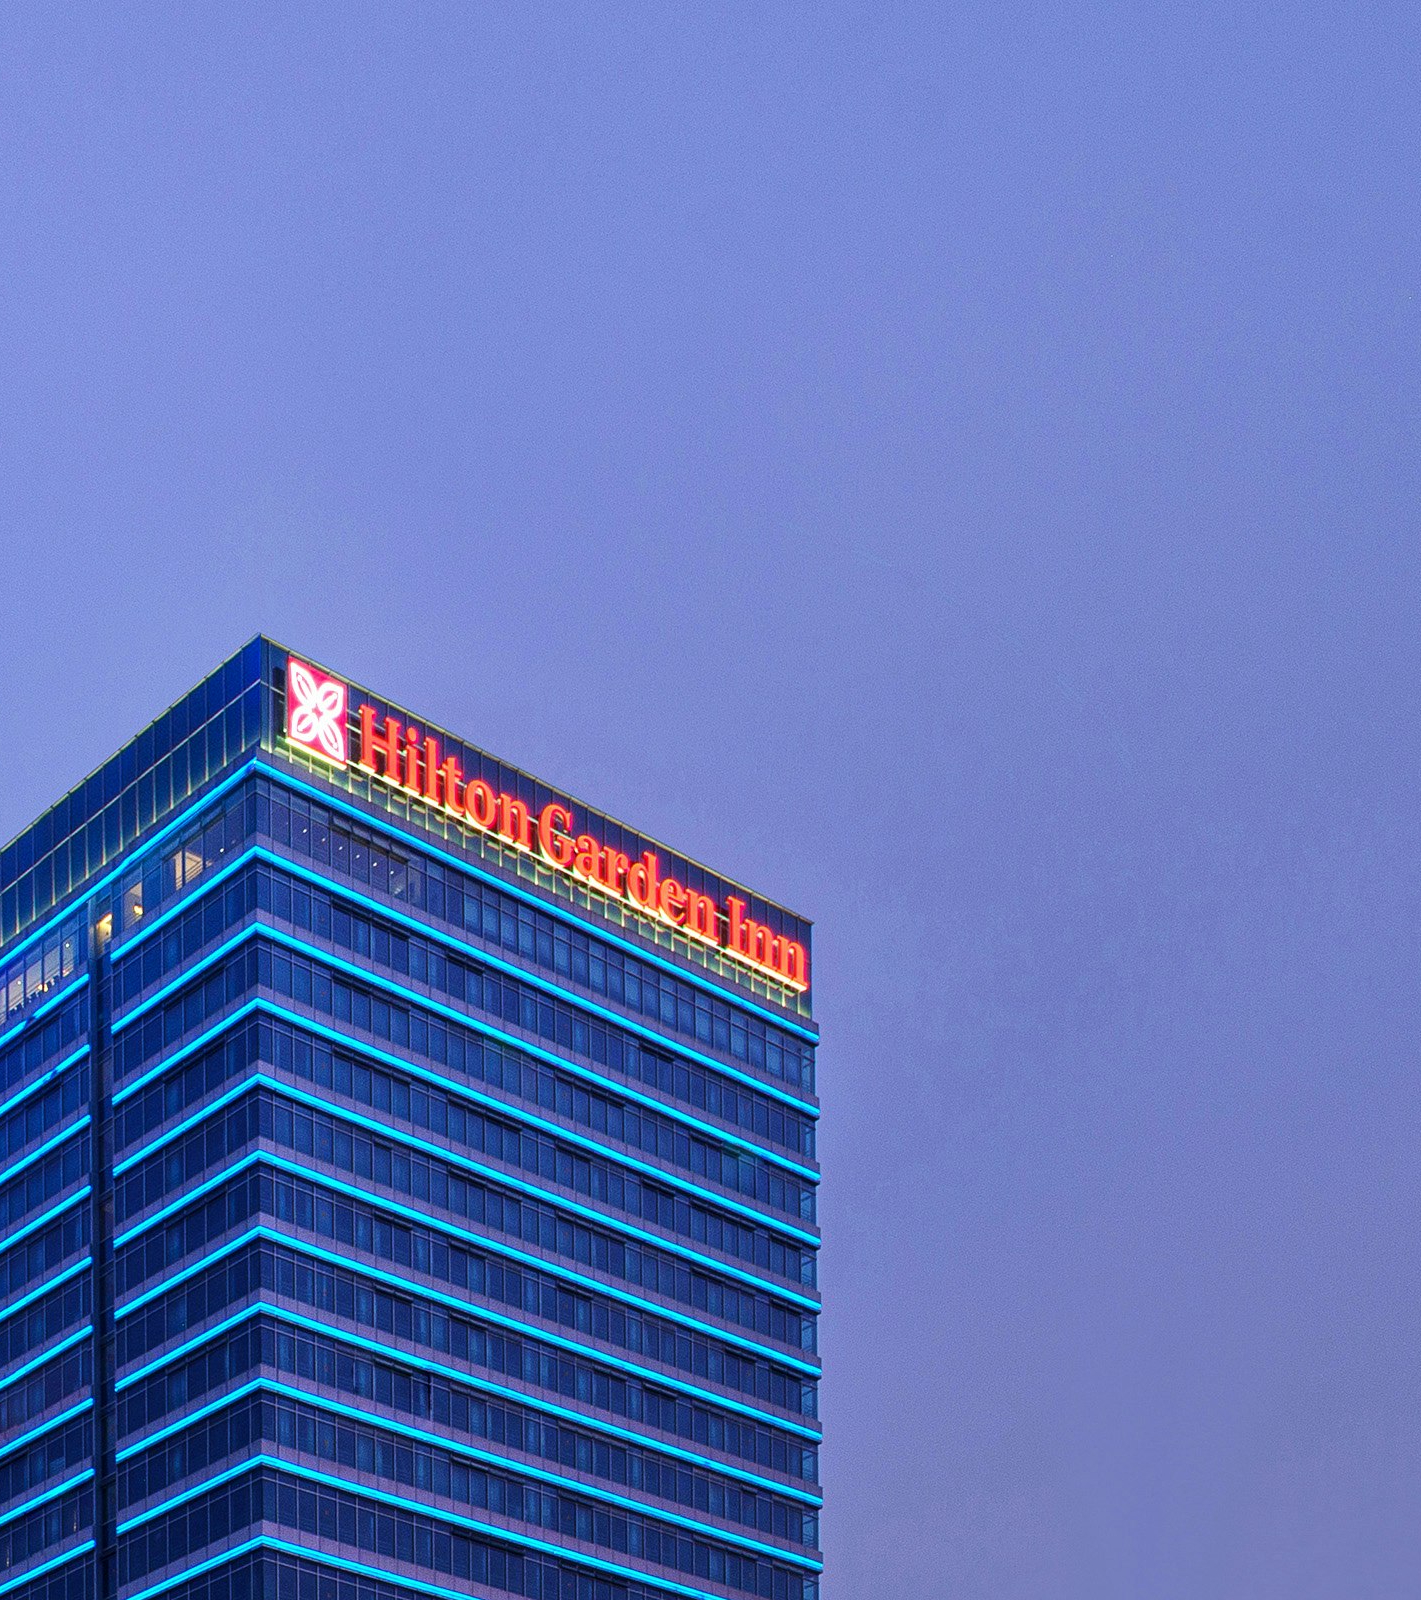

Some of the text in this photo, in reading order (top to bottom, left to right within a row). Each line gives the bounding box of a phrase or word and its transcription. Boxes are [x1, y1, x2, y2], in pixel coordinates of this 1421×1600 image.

[358, 703, 809, 992] Hilton Garden Inn
